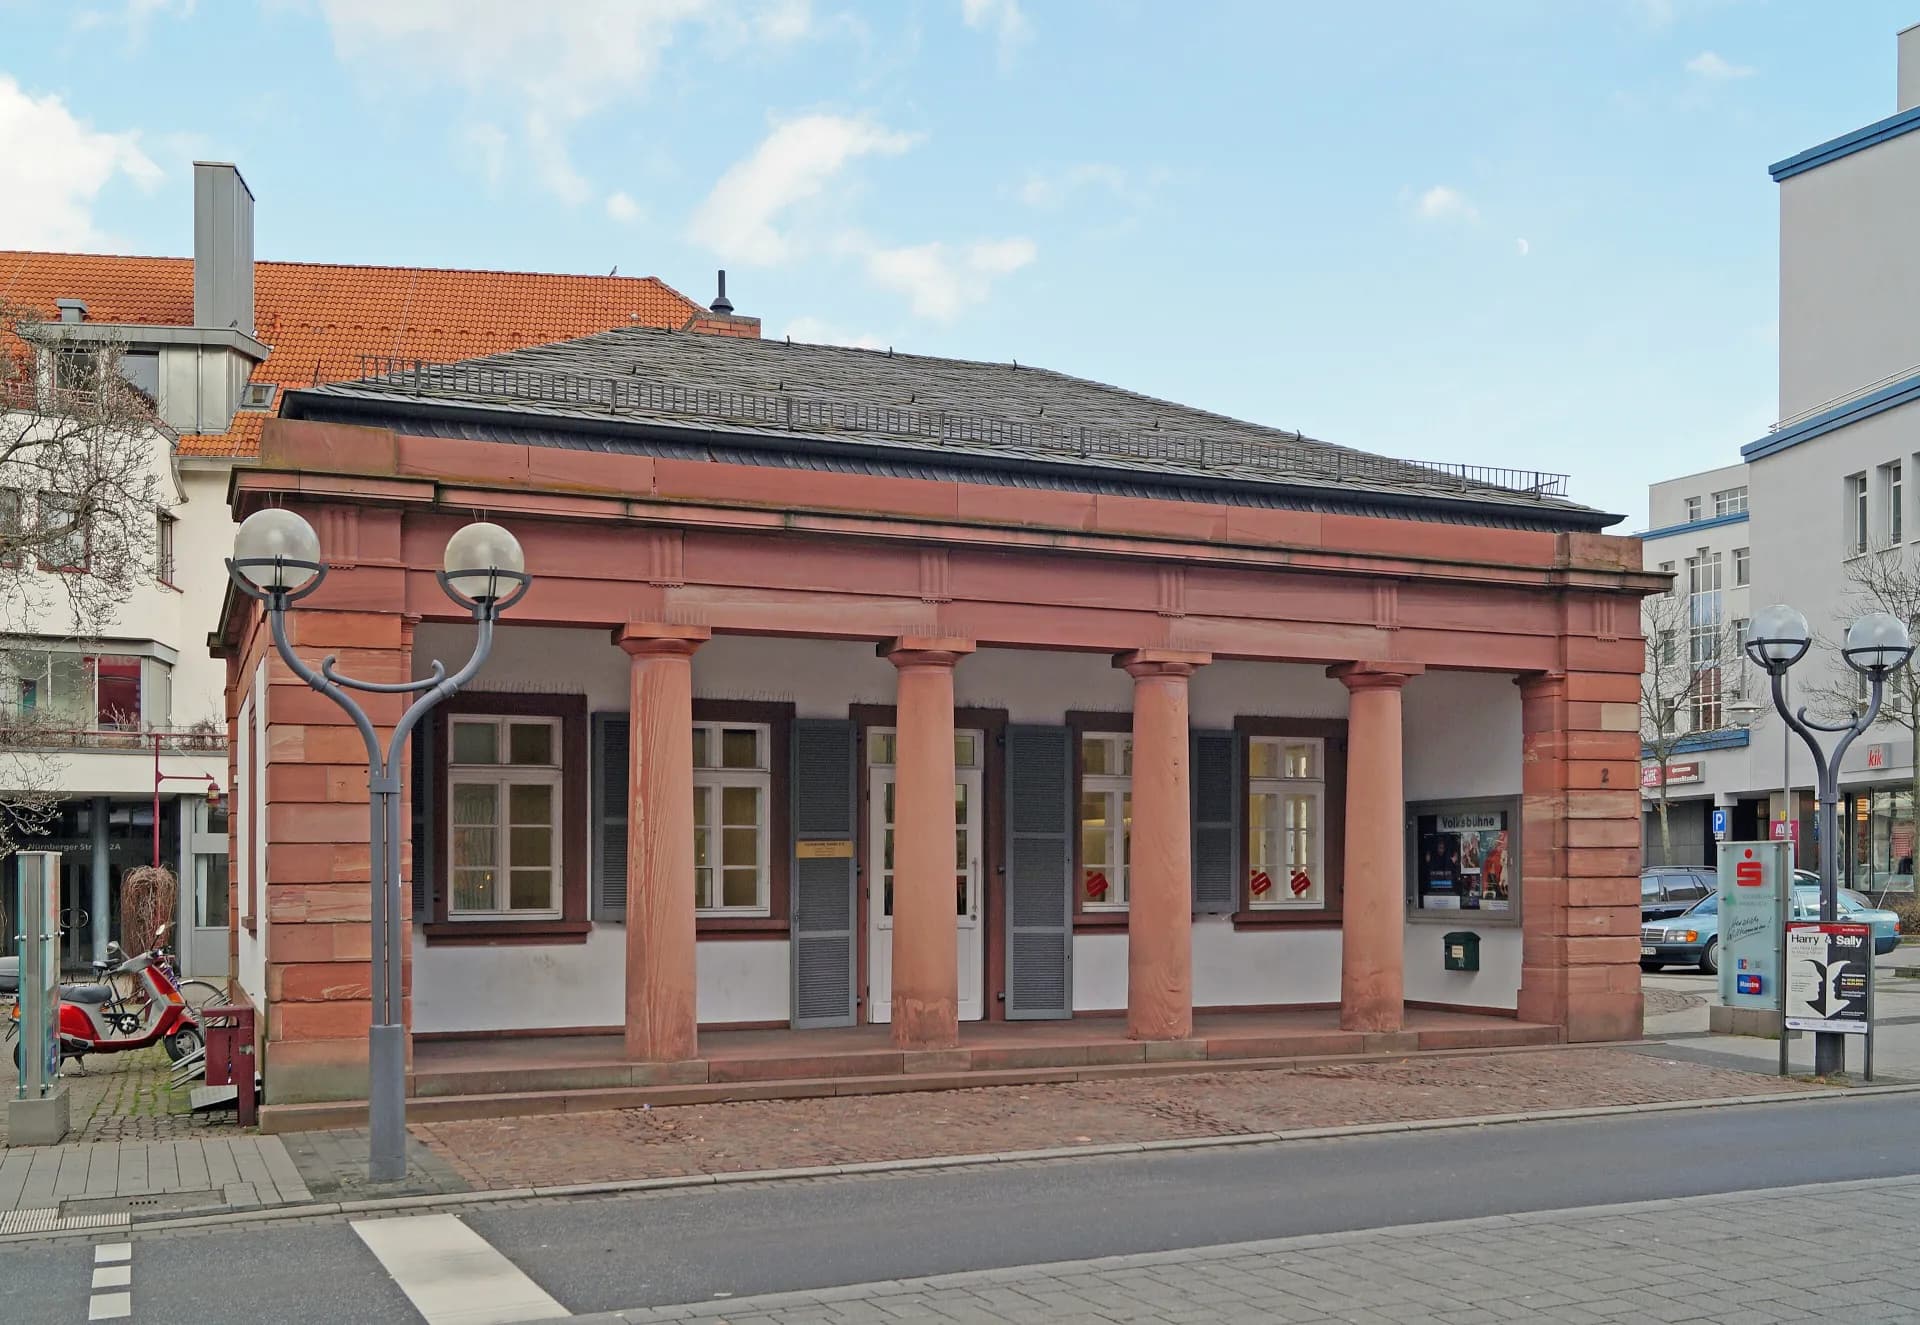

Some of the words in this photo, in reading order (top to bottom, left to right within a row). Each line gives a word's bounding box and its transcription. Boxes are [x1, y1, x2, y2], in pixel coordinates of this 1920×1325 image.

[1601, 767, 1609, 783] 2
[1442, 815, 1495, 829] Volksbühne
[1715, 813, 1724, 830] P
[28, 842, 77, 851] Nürnberger
[1791, 934, 1819, 945] Harry
[1824, 935, 1832, 945] &
[1836, 935, 1863, 948] Sally
